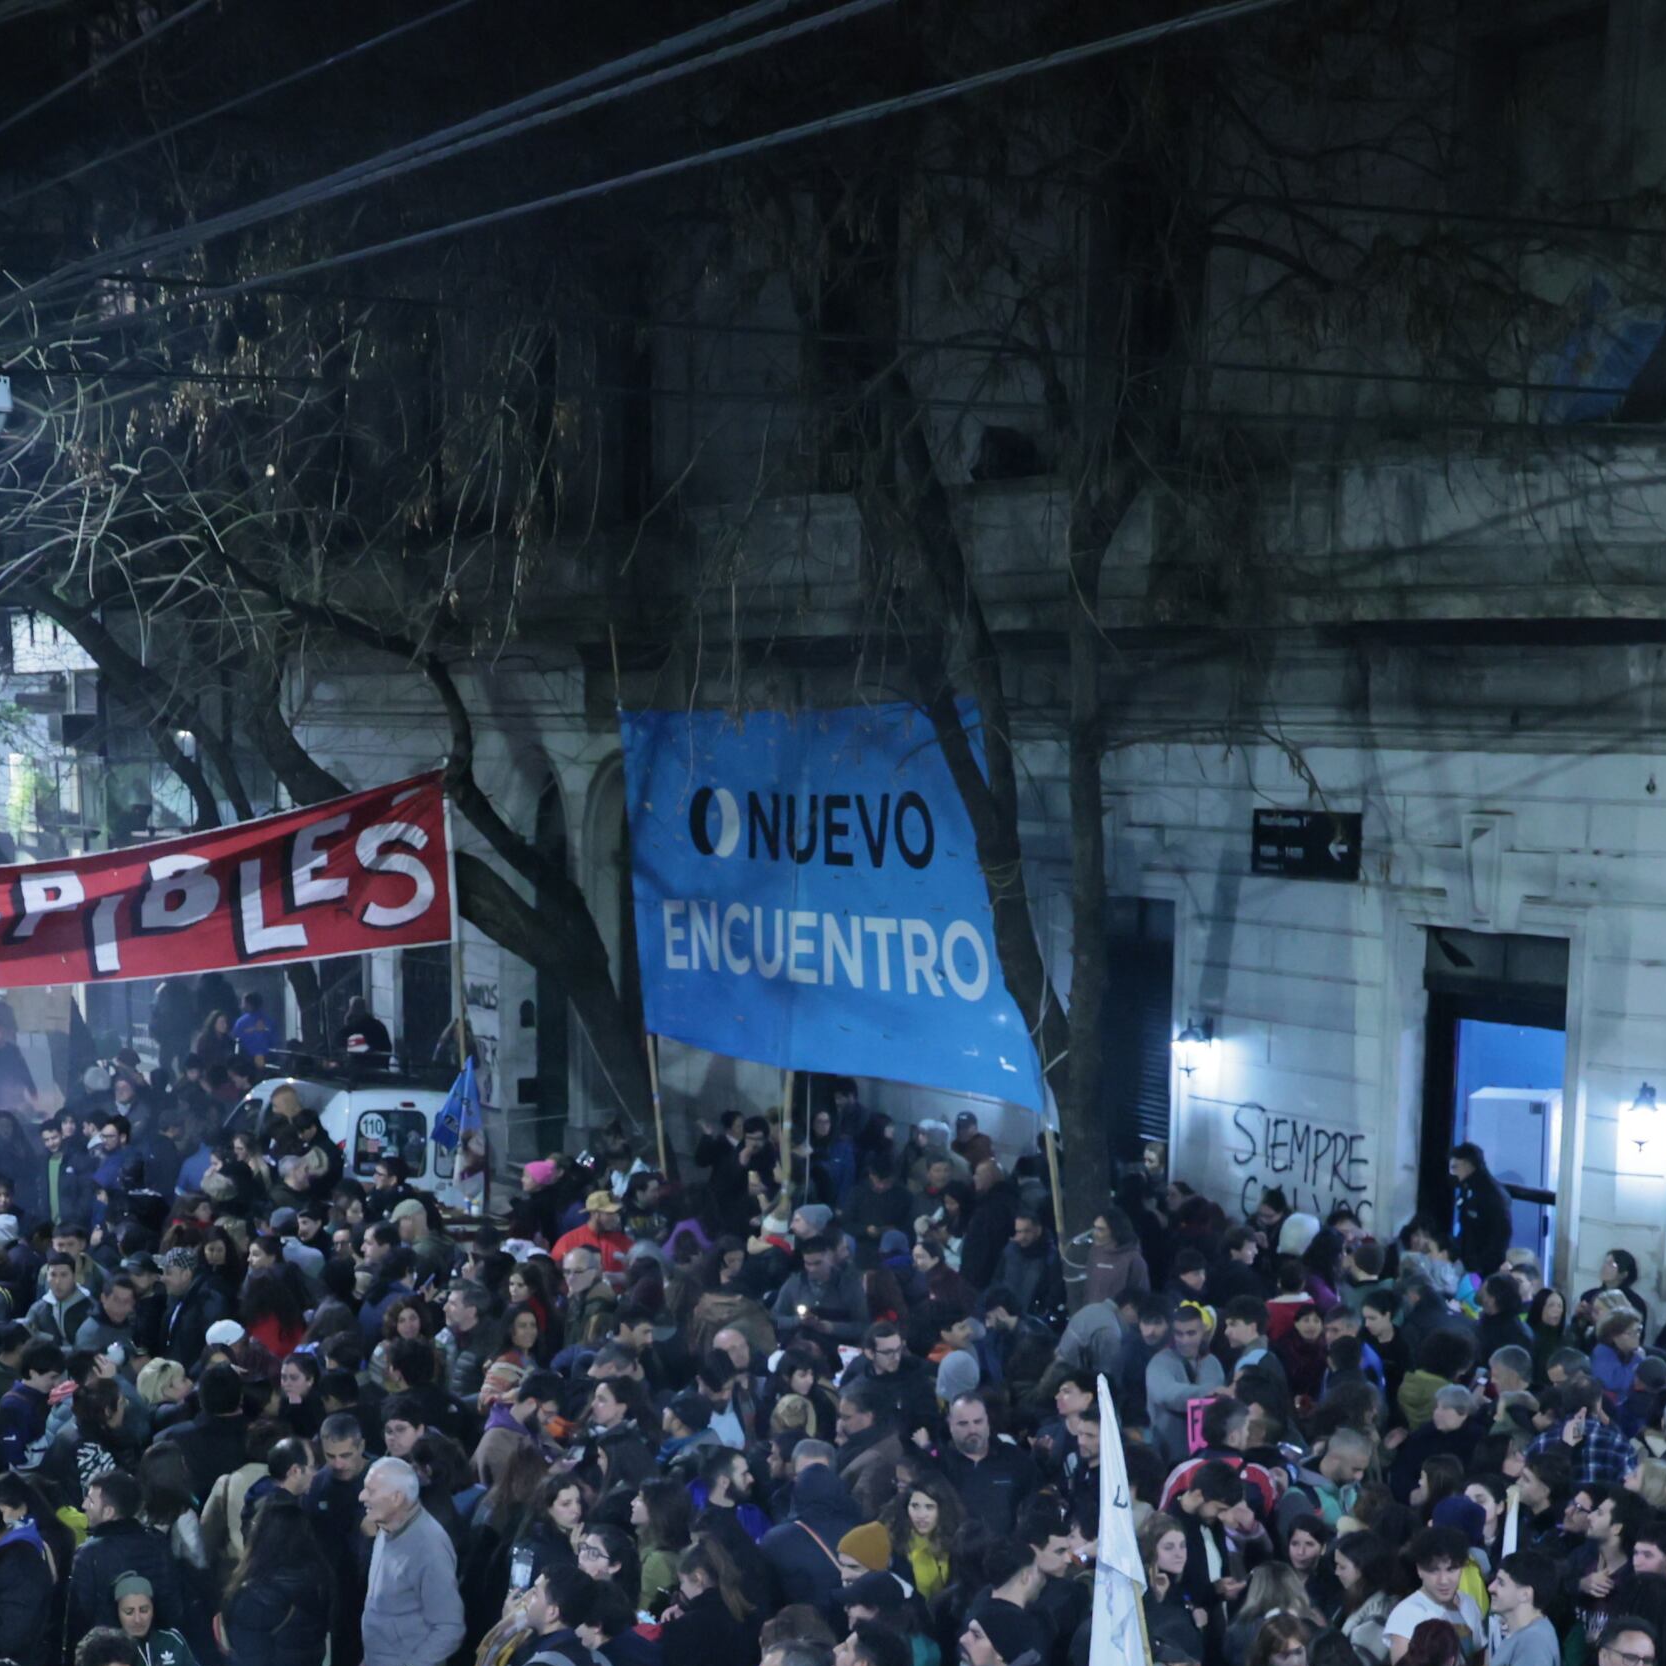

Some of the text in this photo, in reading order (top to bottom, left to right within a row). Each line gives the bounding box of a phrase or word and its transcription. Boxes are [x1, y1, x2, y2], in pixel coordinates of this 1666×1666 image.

[747, 790, 935, 870] NUEVO
[662, 899, 990, 1002] ENCUENTRO
[364, 1119, 384, 1135] 110
[1233, 1101, 1370, 1193] SIEMPRE
